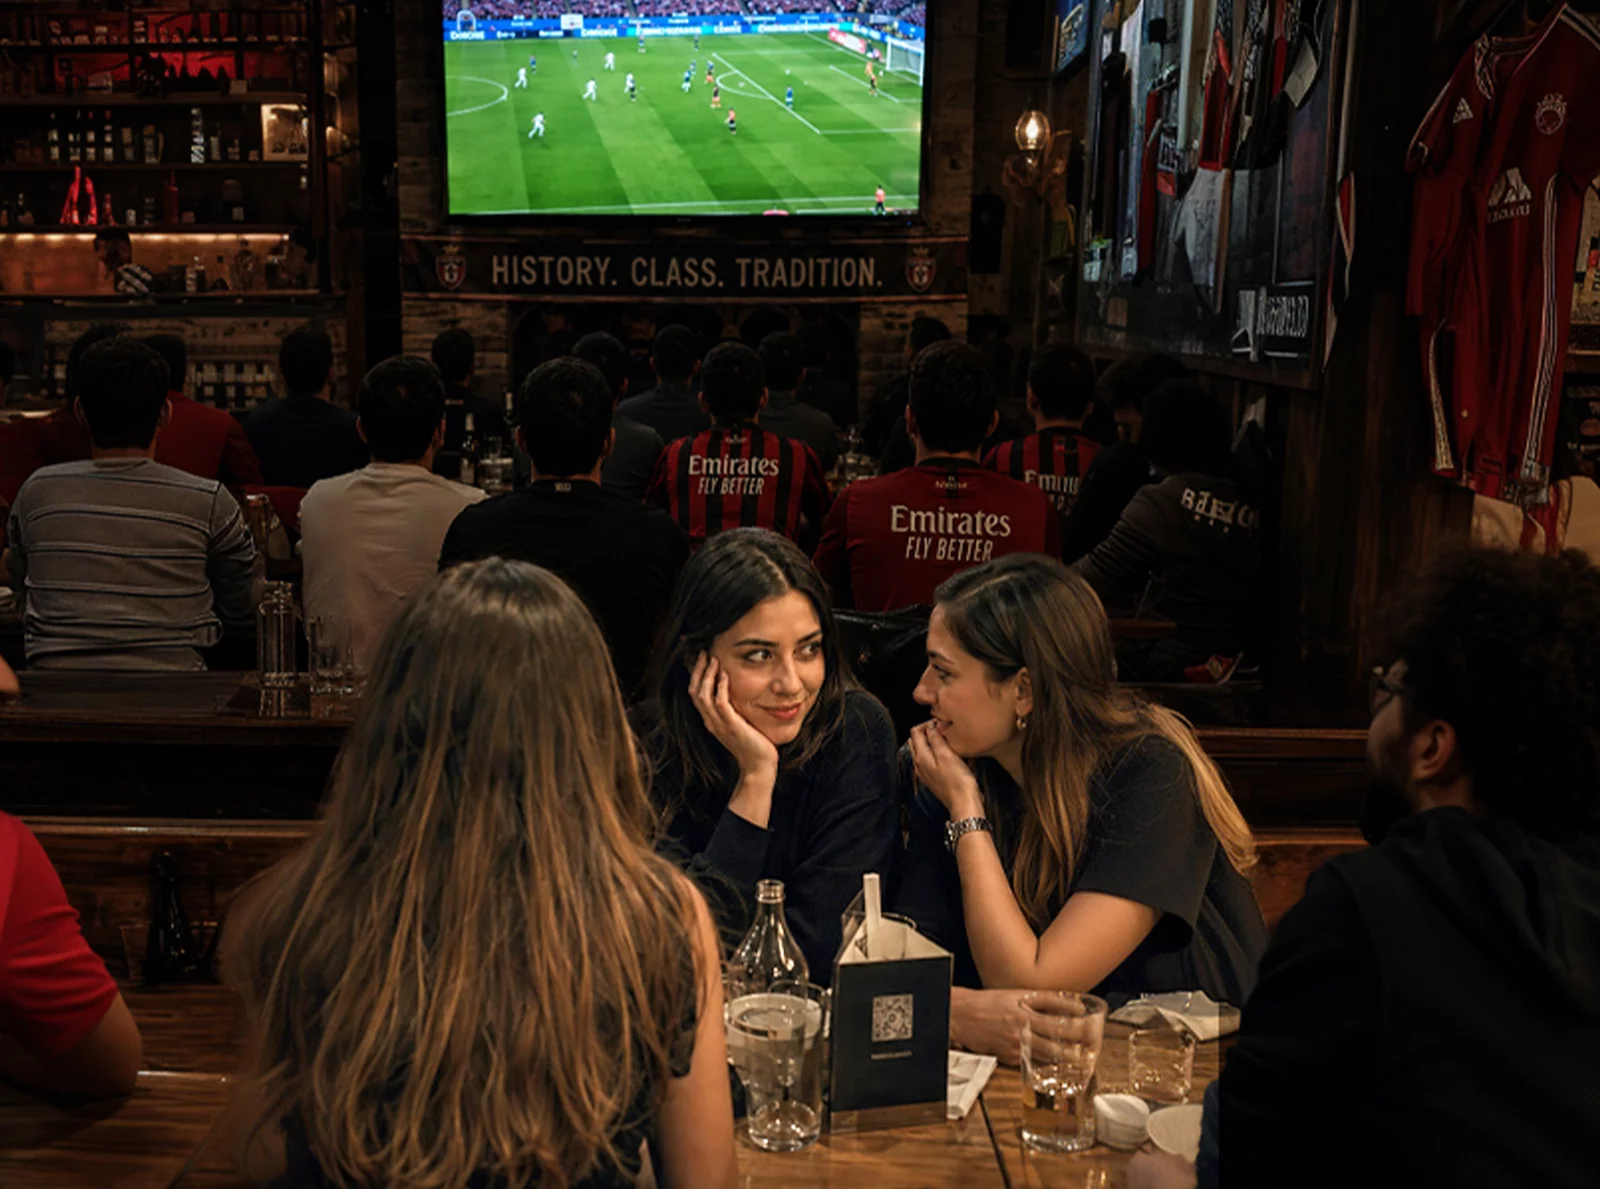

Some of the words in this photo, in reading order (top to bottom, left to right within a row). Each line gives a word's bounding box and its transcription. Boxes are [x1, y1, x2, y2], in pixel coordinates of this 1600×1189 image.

[492, 254, 618, 286] HISTORY.
[631, 256, 724, 288] CLASS.
[735, 256, 883, 288] TRADITION.
[688, 453, 780, 476] Emirates
[697, 476, 719, 495] FLY
[720, 476, 765, 495] BETTER
[890, 504, 1011, 537] Emirates
[905, 536, 932, 560] FLY
[936, 537, 993, 562] BETTER
